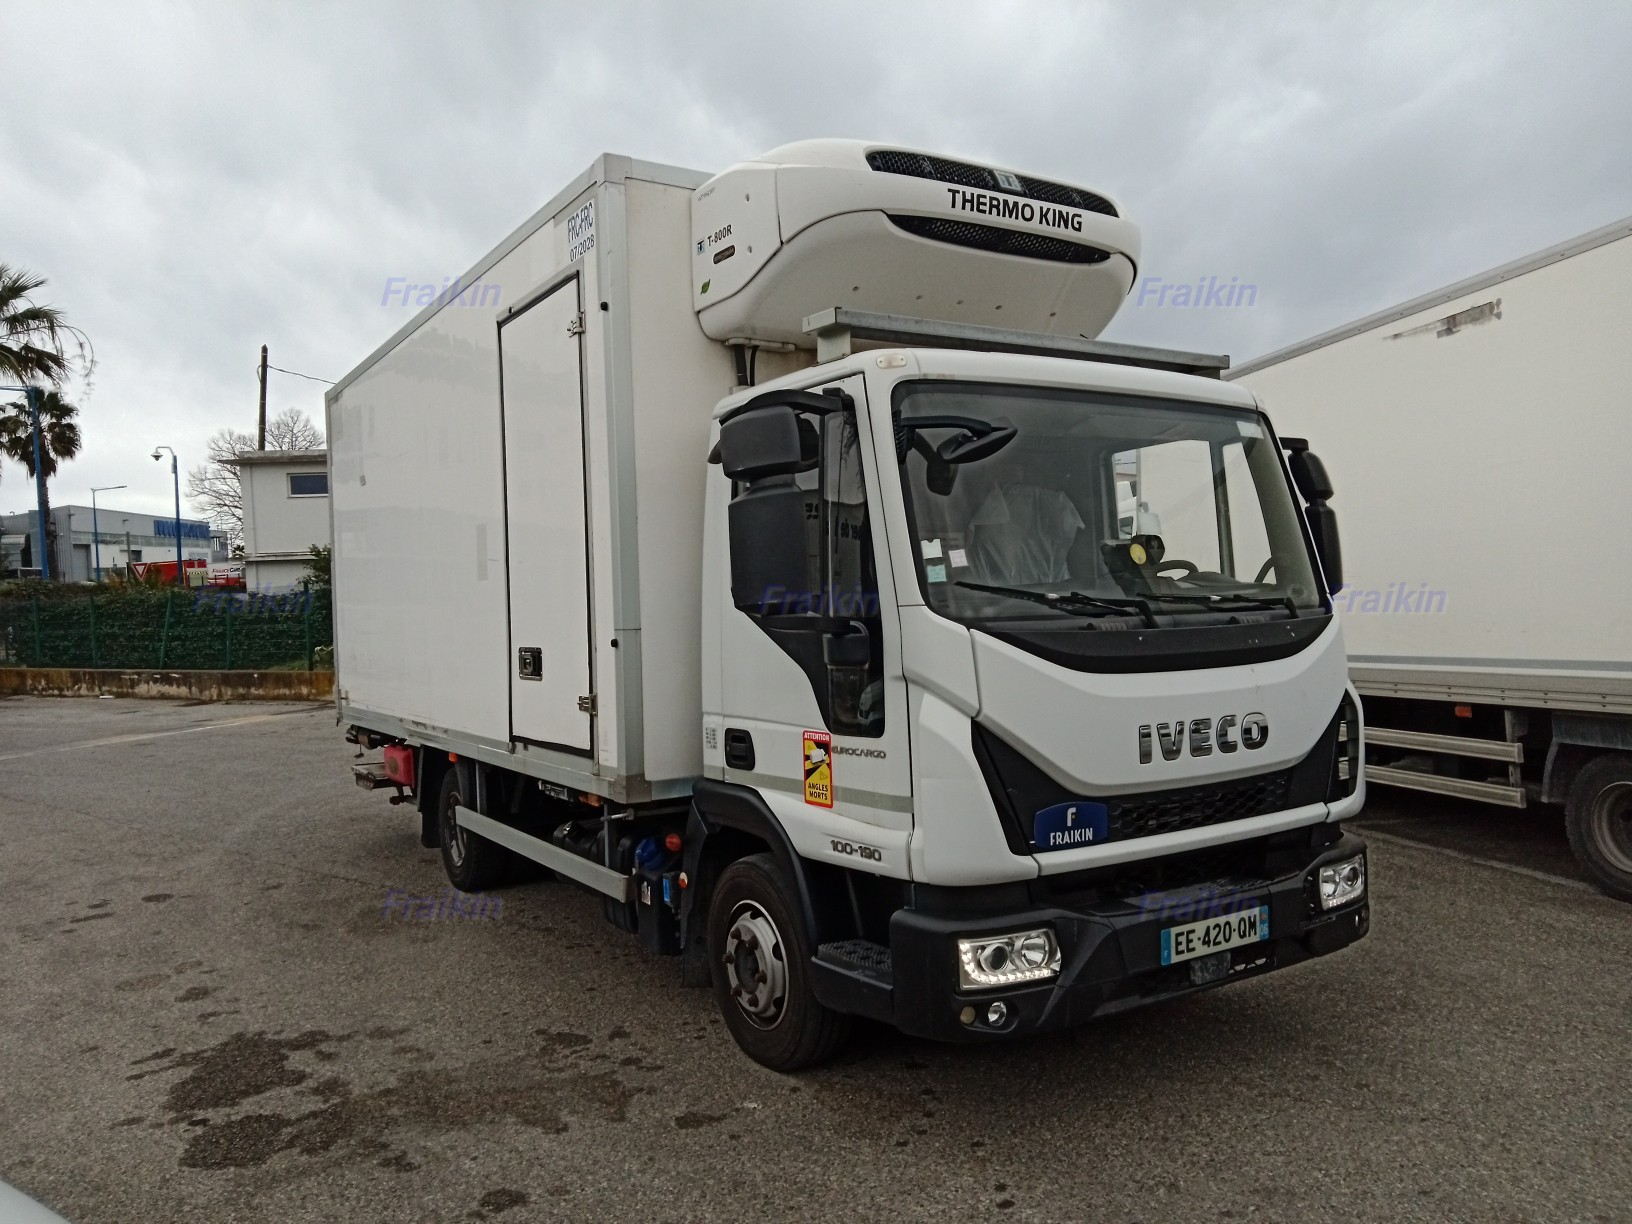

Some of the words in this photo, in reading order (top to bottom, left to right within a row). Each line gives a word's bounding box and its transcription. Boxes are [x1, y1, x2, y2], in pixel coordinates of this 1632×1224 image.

[947, 188, 1035, 222] THERMO
[1038, 205, 1083, 233] KING
[707, 224, 733, 247] T-800R
[803, 731, 830, 742] ATTENTION
[1138, 711, 1269, 765] IVECO
[831, 745, 887, 759] EUROCARGO
[807, 781, 829, 793] ANGLES
[808, 790, 828, 801] MORTS
[1050, 827, 1093, 846] FRAIKIN
[830, 840, 882, 862] 100-190
[1259, 923, 1269, 936] 06
